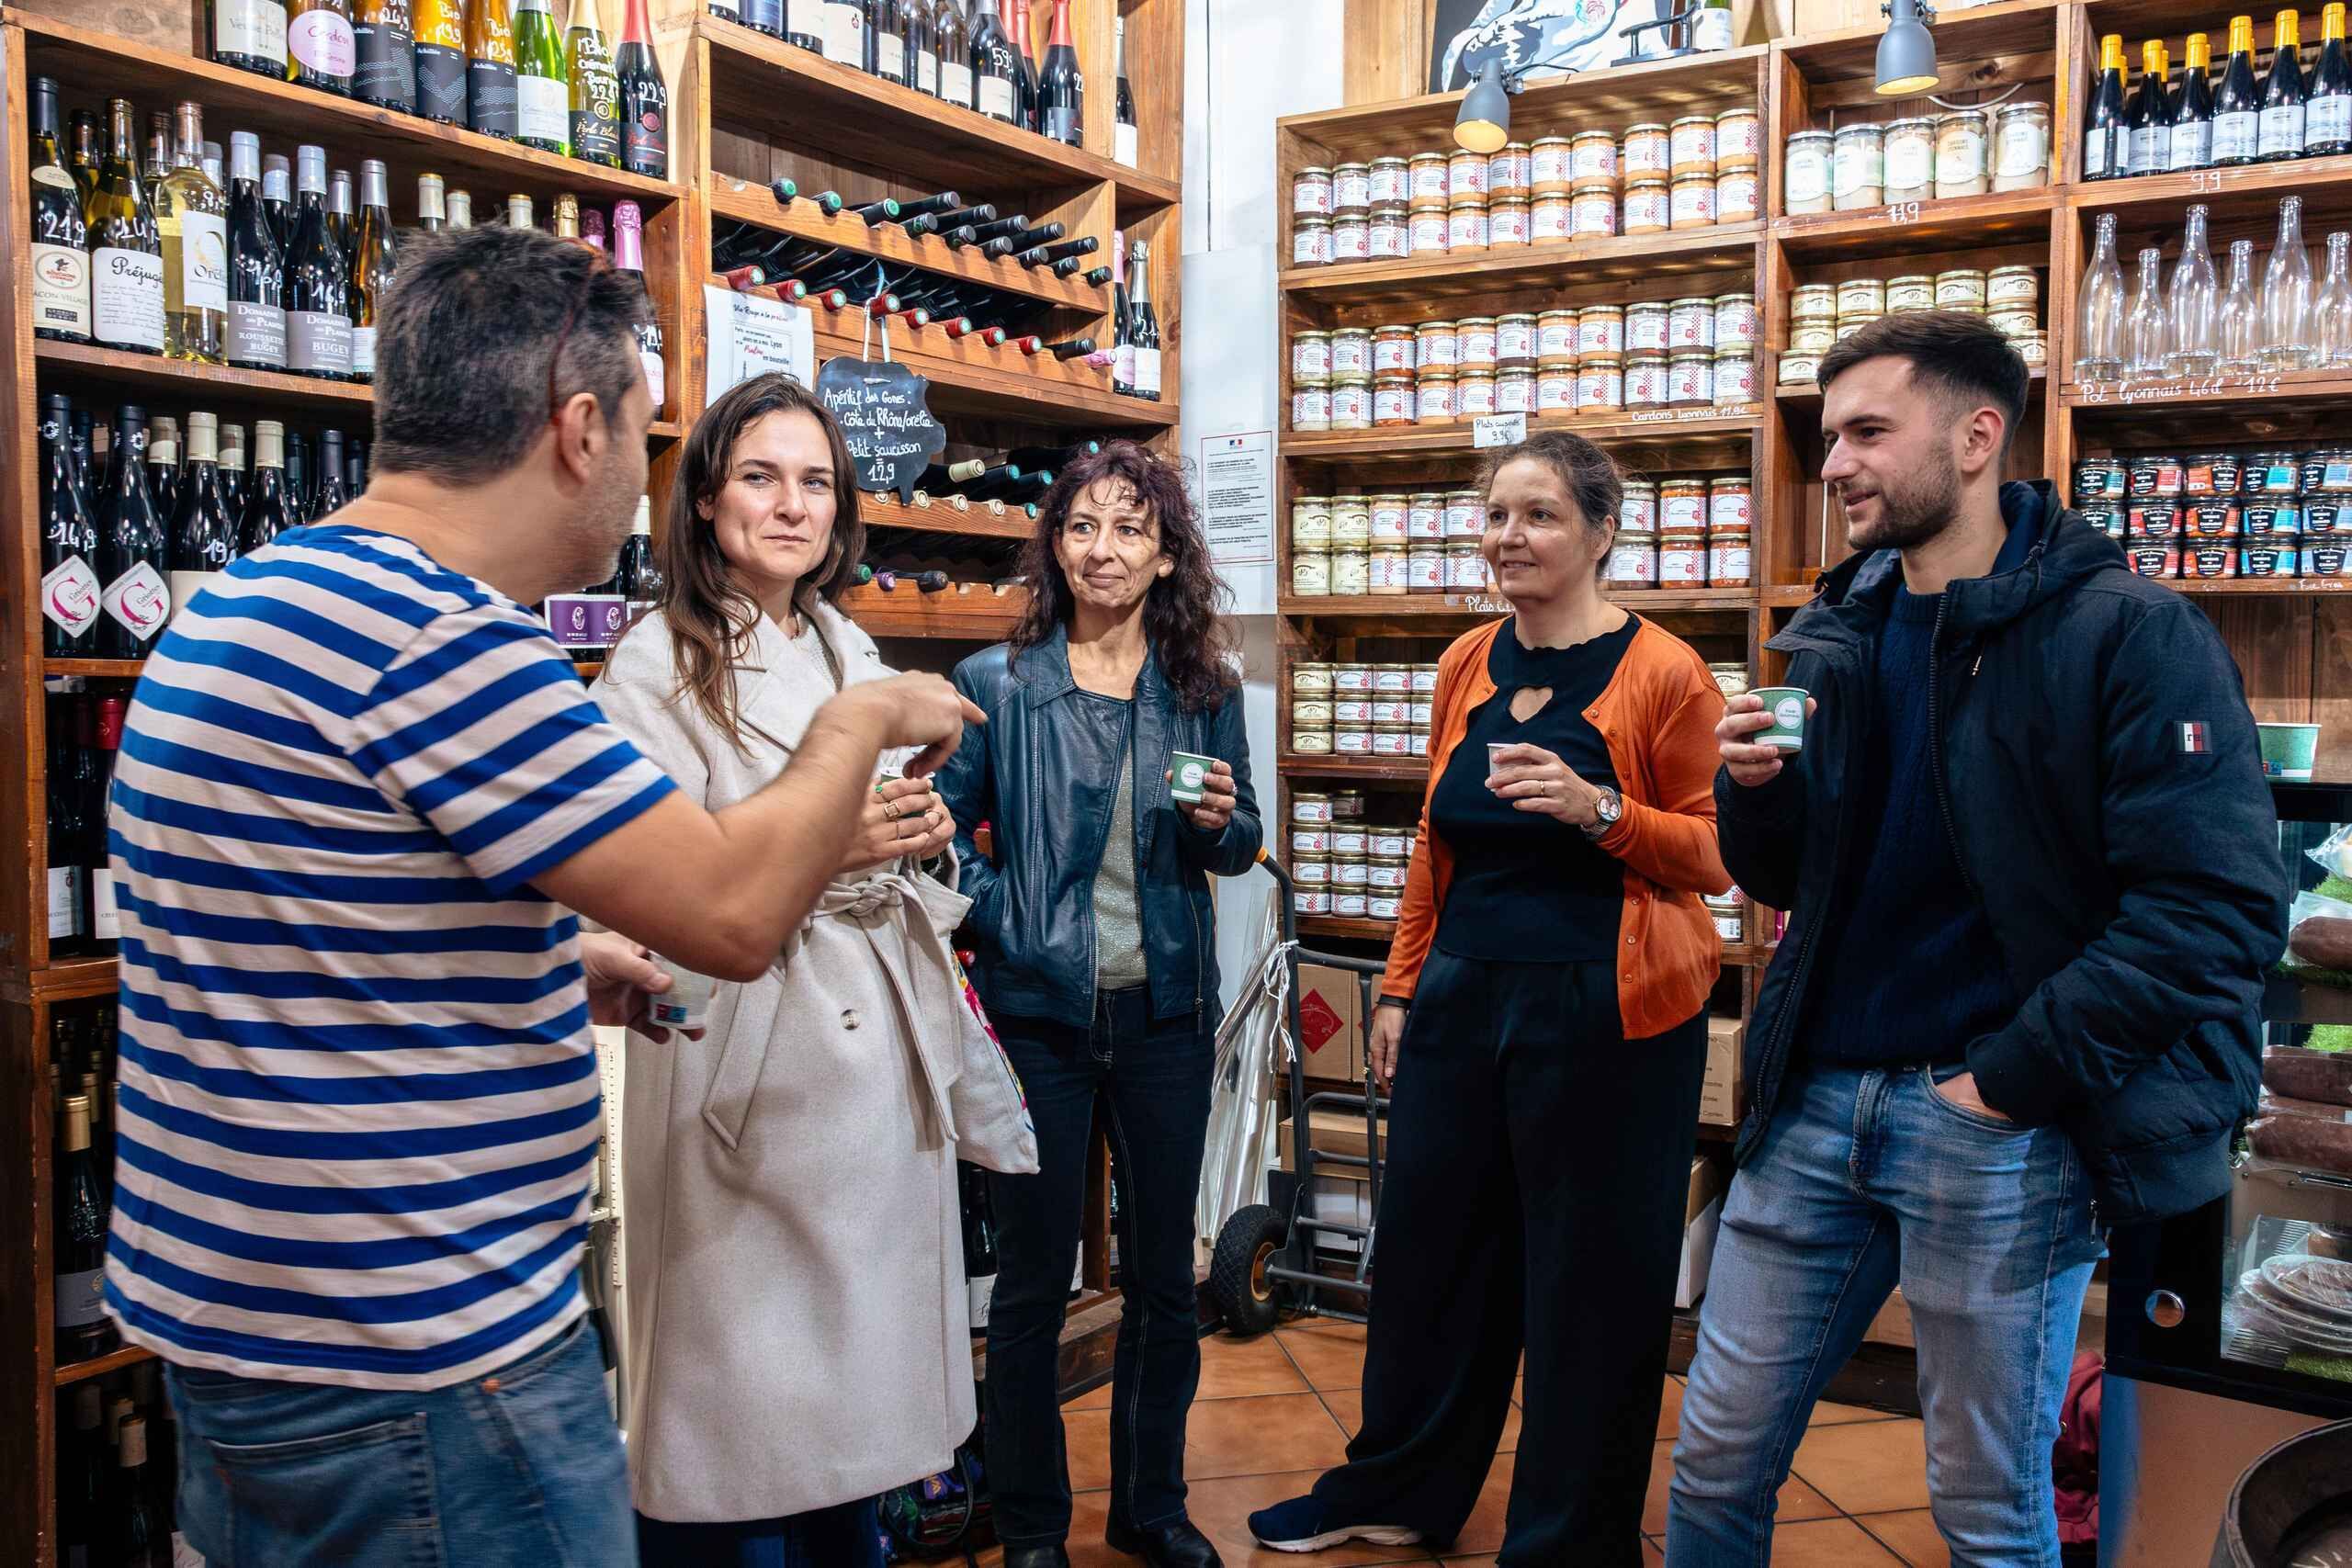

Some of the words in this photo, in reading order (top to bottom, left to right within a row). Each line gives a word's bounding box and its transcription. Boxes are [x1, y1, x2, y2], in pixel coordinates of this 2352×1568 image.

[823, 387, 863, 412] Apéritif
[2080, 383, 2108, 403] Pot
[867, 463, 896, 485] 12,9
[1464, 595, 1495, 613] Plats
